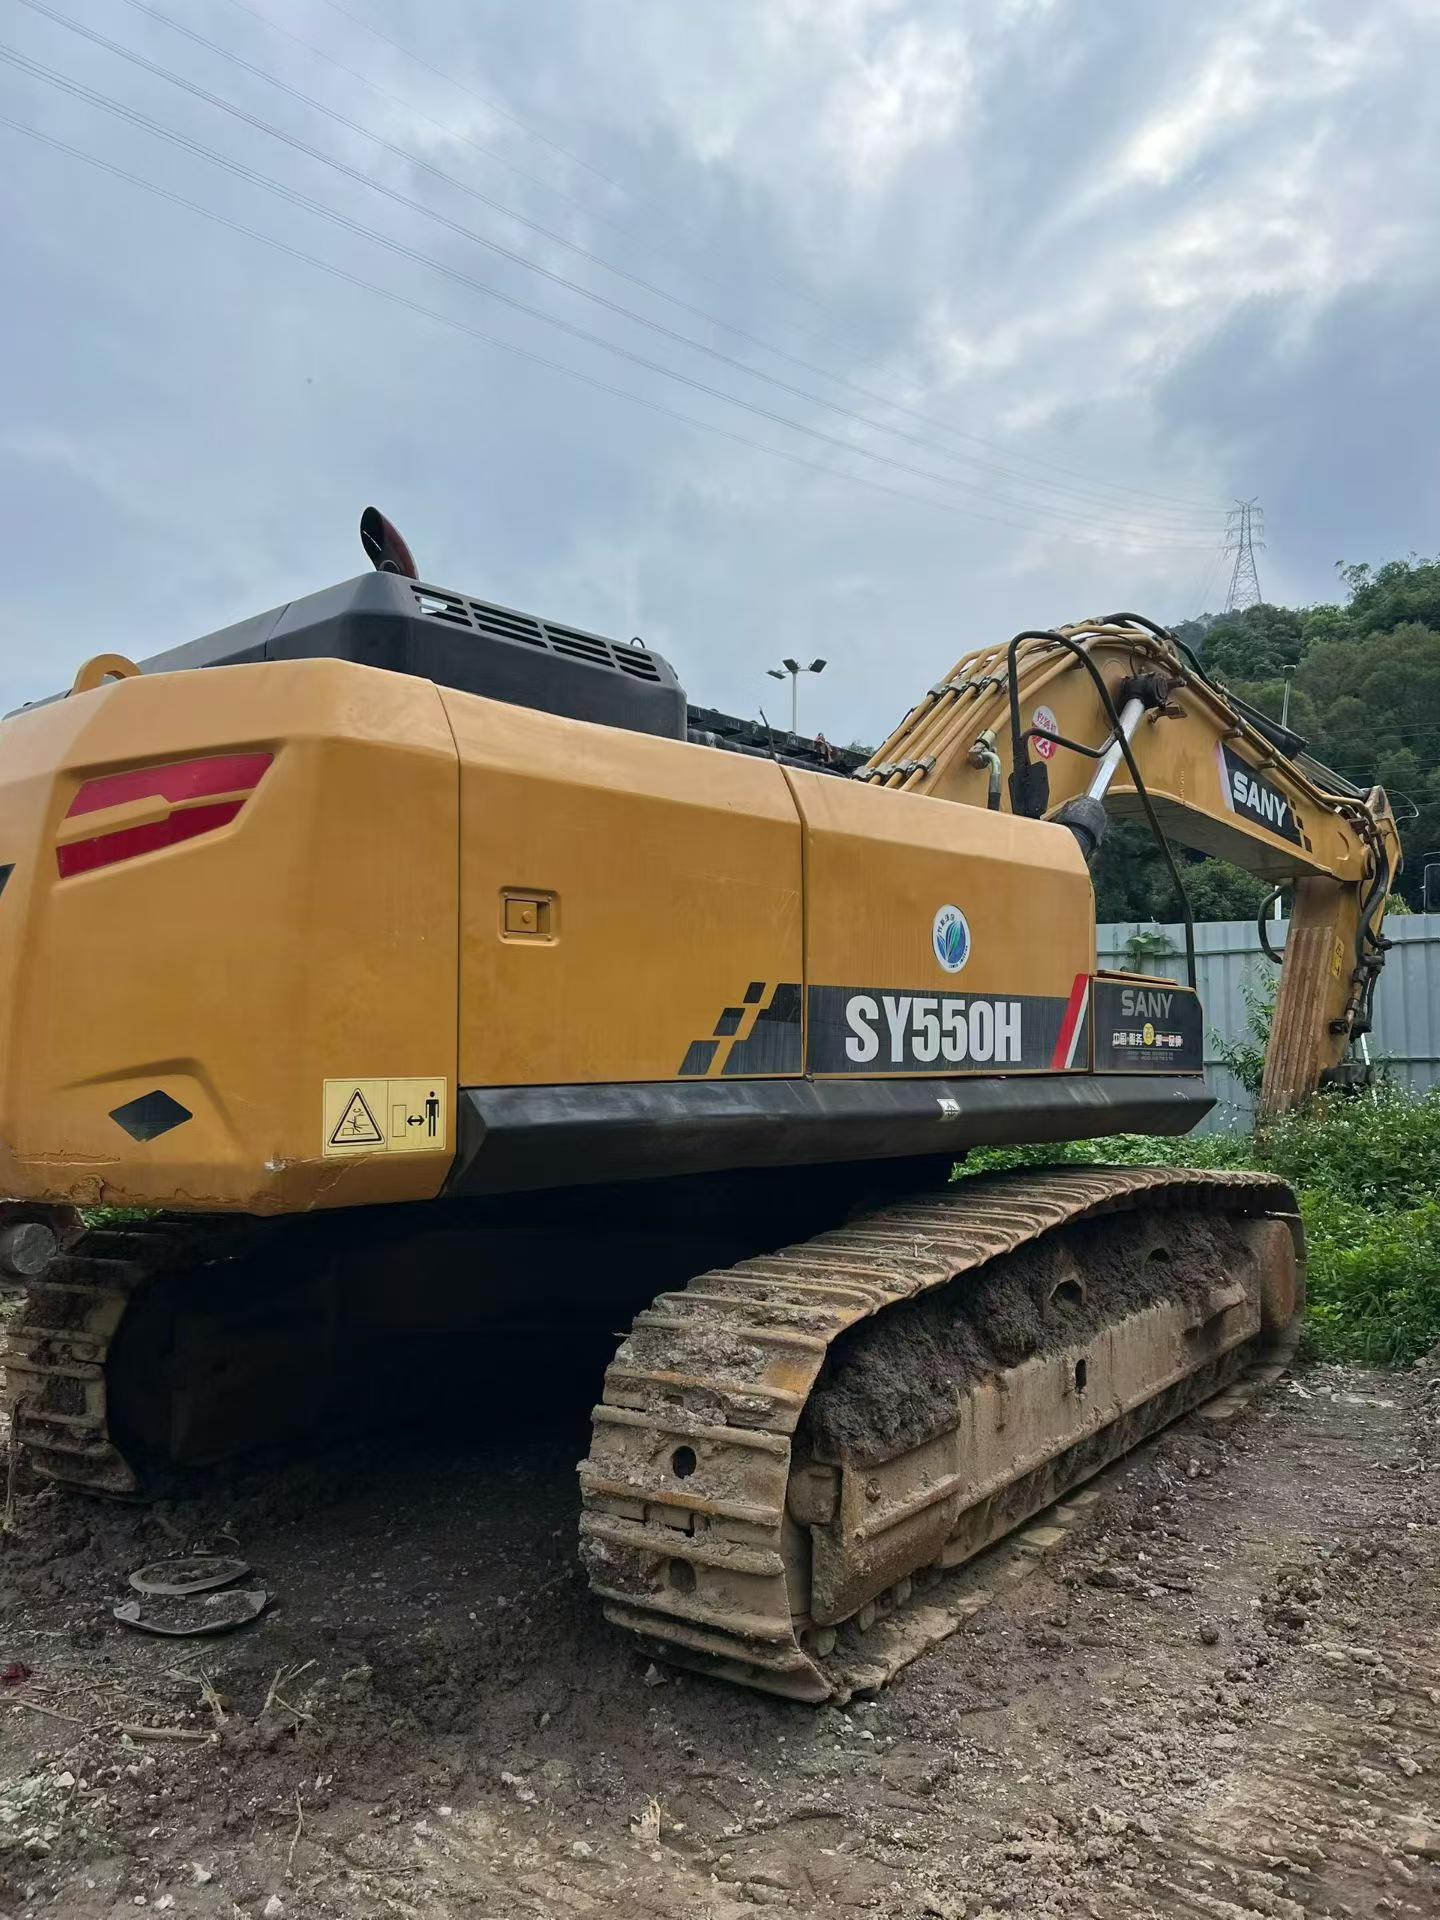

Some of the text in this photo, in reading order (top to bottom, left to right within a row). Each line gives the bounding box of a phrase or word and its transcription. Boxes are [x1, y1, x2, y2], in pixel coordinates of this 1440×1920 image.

[1233, 770, 1288, 828] SANY
[845, 995, 1022, 1062] SY550H
[1121, 989, 1174, 1019] SANY
